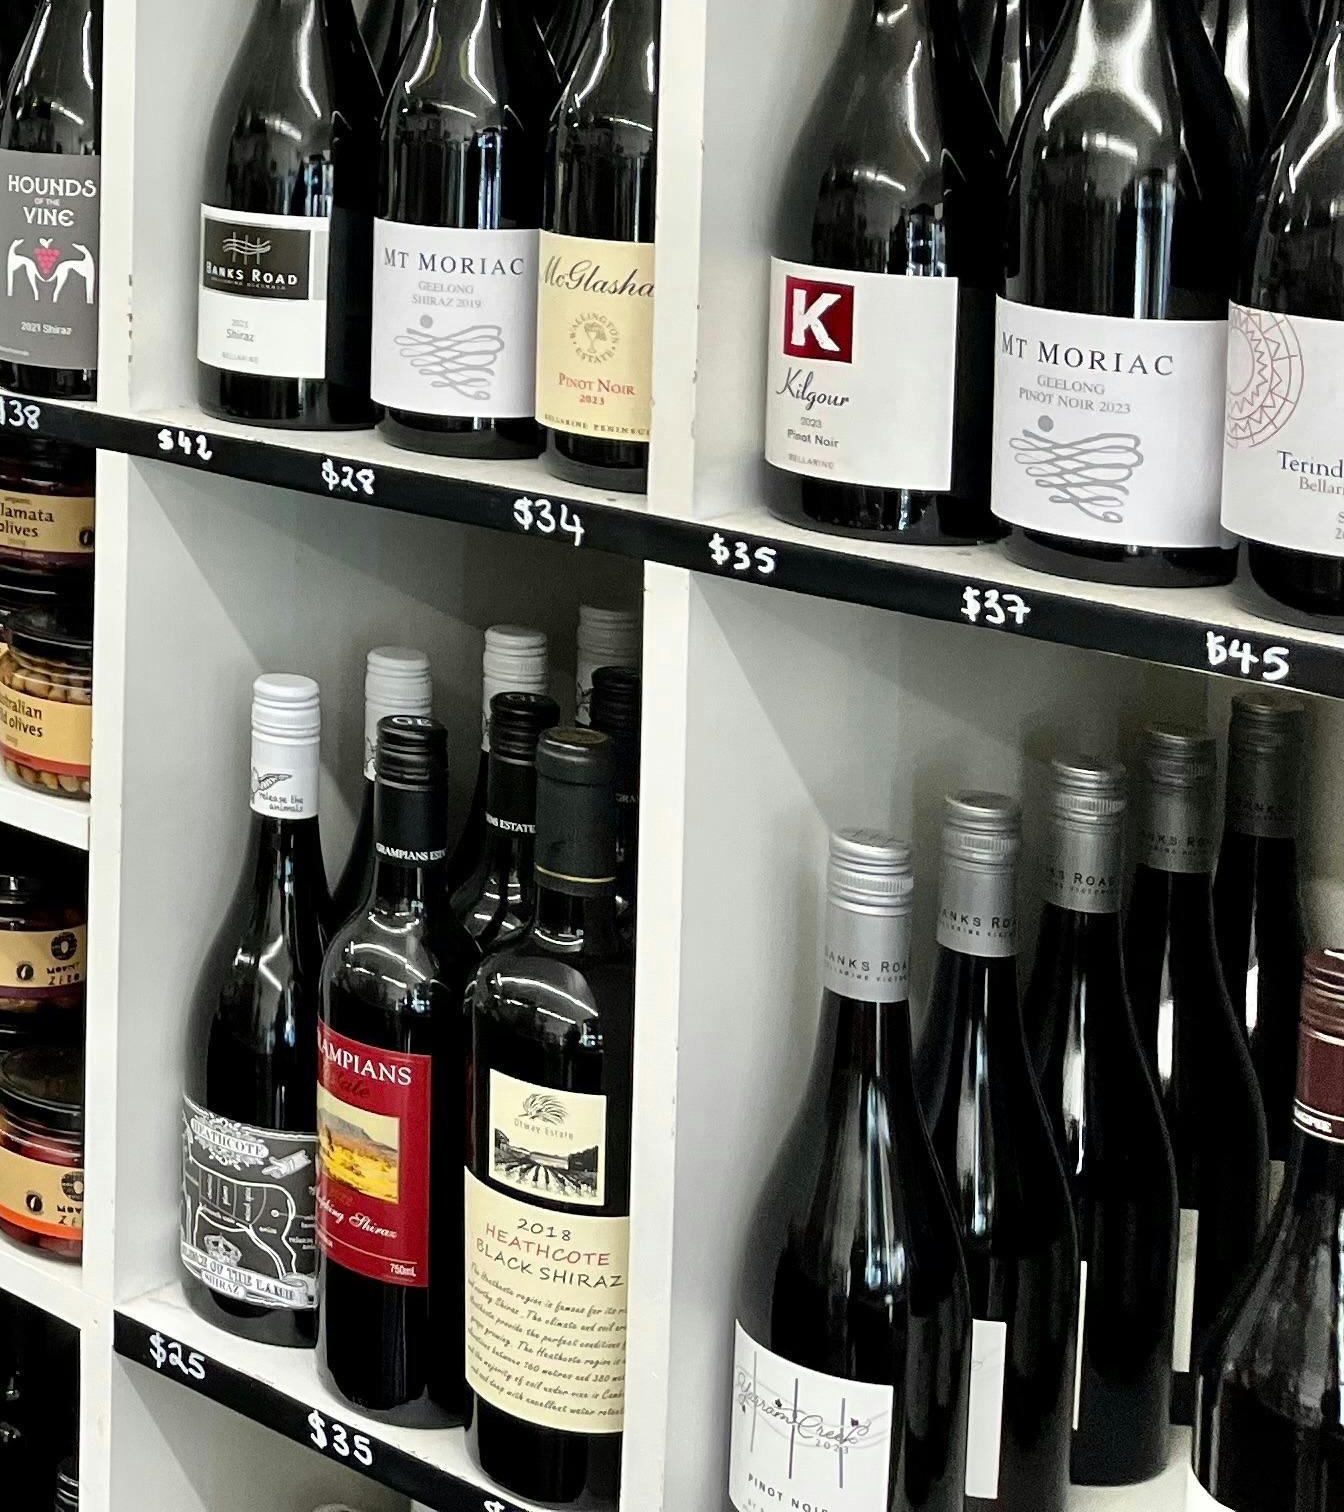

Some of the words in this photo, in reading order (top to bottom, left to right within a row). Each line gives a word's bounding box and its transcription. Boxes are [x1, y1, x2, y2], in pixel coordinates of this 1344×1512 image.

[8, 174, 97, 197] HOUNDS
[23, 206, 75, 227] VINE
[206, 260, 245, 282] BANKS
[251, 268, 299, 287] ROAD
[384, 248, 411, 269] MT
[418, 253, 526, 277] MORIAC
[544, 254, 655, 299] McGlasha
[412, 295, 453, 308] SHIRAZ
[455, 297, 482, 310] 2019
[418, 280, 475, 294] GEELONG
[790, 287, 842, 352] K
[1001, 331, 1029, 360] MT
[1037, 340, 1175, 377] MORIAC
[557, 372, 594, 393] PINOT
[597, 377, 636, 397] NOIR
[775, 366, 850, 411] Kilgour
[1018, 388, 1055, 409] PINOT
[1057, 395, 1094, 413] NOIR
[1098, 399, 1132, 415] 2023
[1036, 373, 1106, 396] GEELONG
[157, 427, 214, 462] $42
[787, 429, 812, 446] Pinot
[814, 433, 839, 449] Noir
[321, 461, 376, 495] $28
[513, 497, 585, 546] $34
[708, 532, 778, 575] $35
[960, 585, 1032, 625] $37
[1205, 630, 1290, 681] $45
[485, 1221, 611, 1268] HEATHCOTE
[517, 1218, 572, 1242] 2018
[476, 1238, 533, 1275] BLACK
[539, 1266, 625, 1290] SHIRAZ
[148, 1331, 207, 1380] $25
[307, 1408, 375, 1467] $35
[748, 1473, 783, 1501] PINOT
